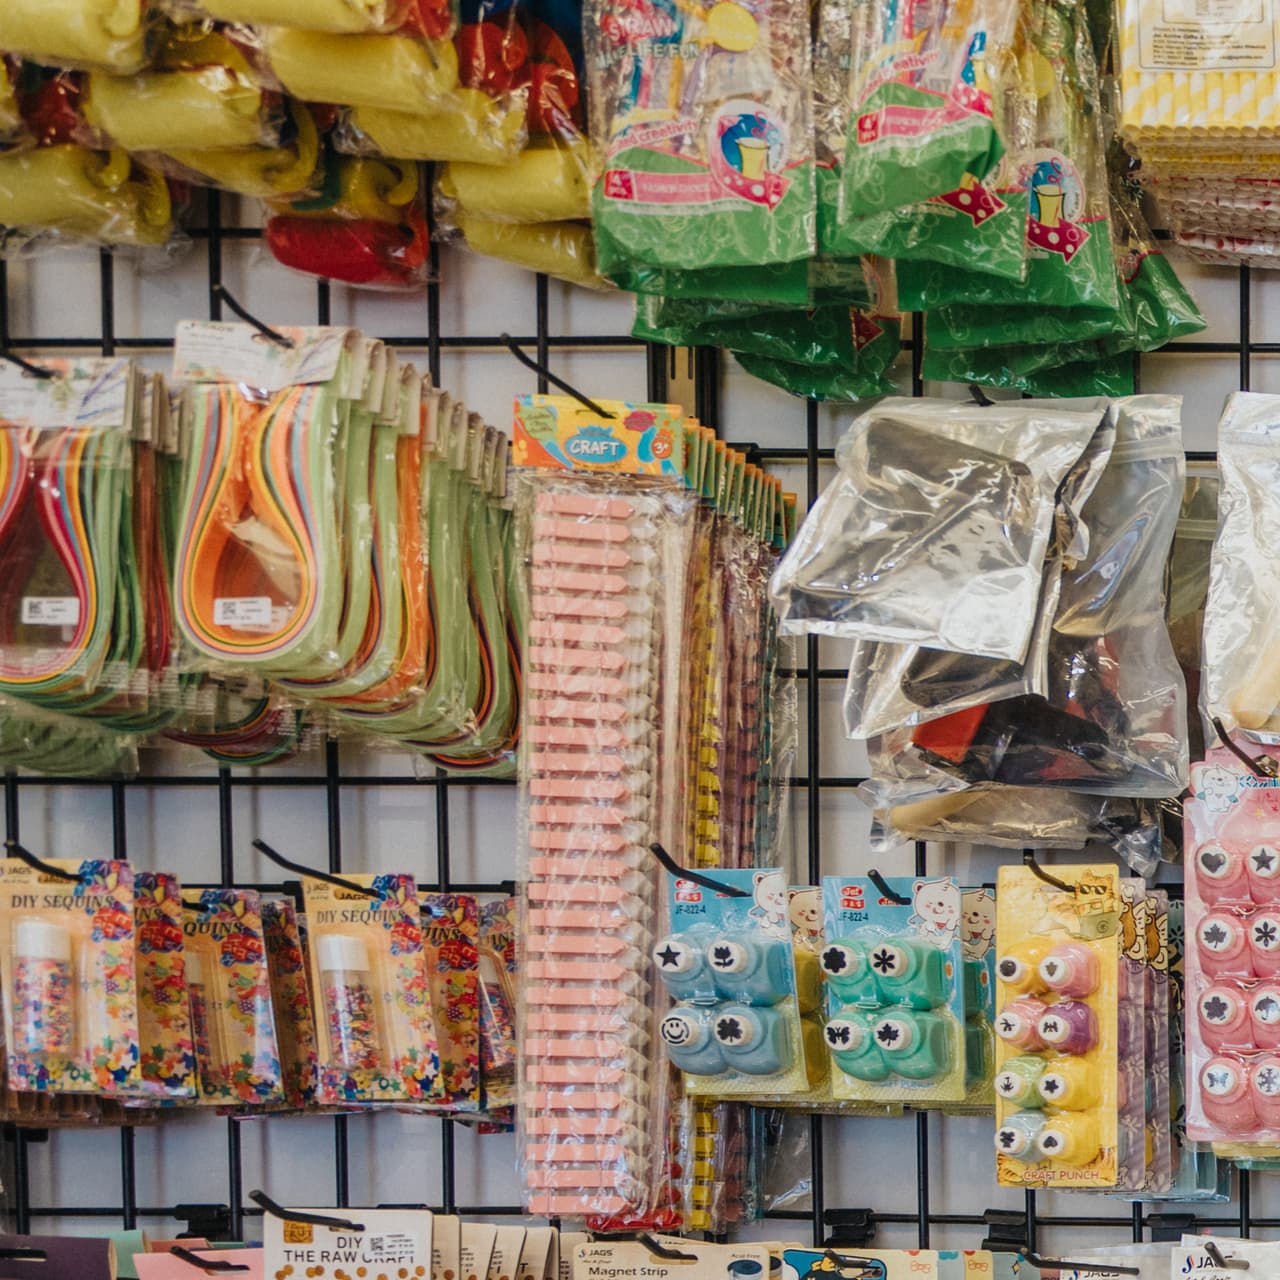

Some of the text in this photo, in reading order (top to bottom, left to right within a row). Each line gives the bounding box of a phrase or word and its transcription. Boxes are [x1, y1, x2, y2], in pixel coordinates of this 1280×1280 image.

[569, 437, 620, 457] CRAFT
[11, 894, 115, 910] DIY SEQUINS
[317, 909, 406, 926] DIY SEQUINS
[1024, 1171, 1099, 1180] CRAFT PUNCH
[336, 1237, 362, 1249] DIY
[284, 1250, 357, 1262] THE RAW
[588, 1267, 668, 1278] Magnet Strip
